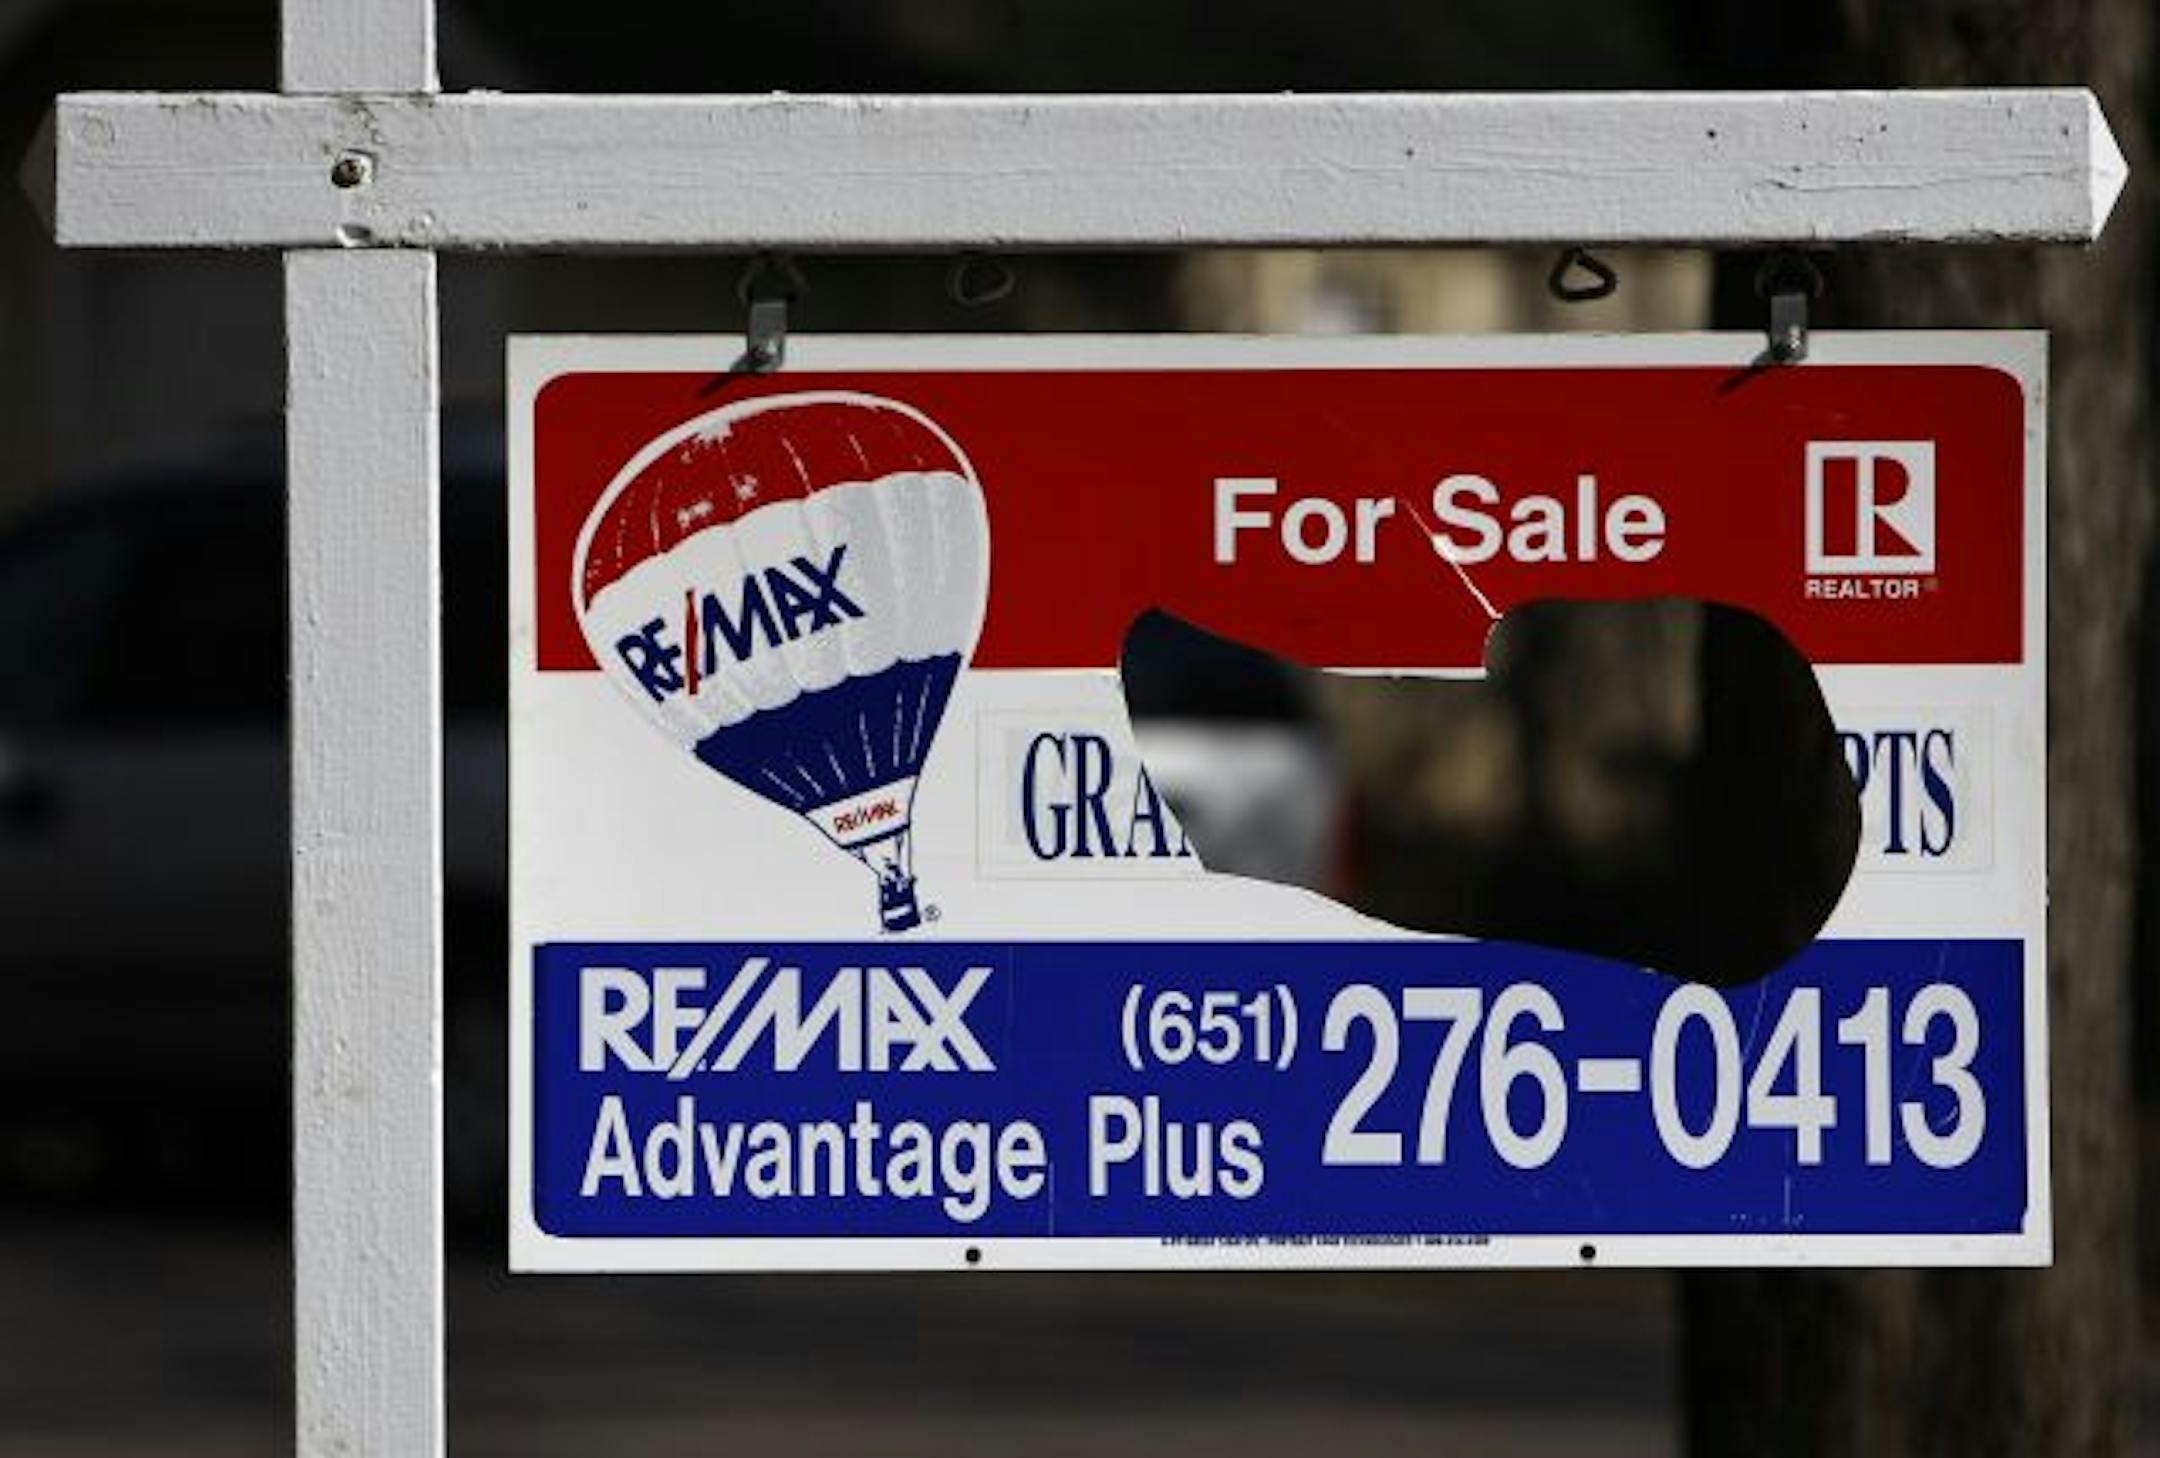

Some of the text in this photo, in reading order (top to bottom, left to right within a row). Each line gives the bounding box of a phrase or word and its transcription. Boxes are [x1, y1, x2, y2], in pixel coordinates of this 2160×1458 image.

[1213, 473, 1667, 565] For Sale
[615, 543, 865, 702] RE/MAX
[833, 798, 900, 834] RE/MAX
[1022, 732, 1192, 861] GRA
[579, 956, 997, 1080] RE/MAX
[1121, 982, 1987, 1169] (651) 276-0413
[579, 1094, 1265, 1223] Advantage Plus
